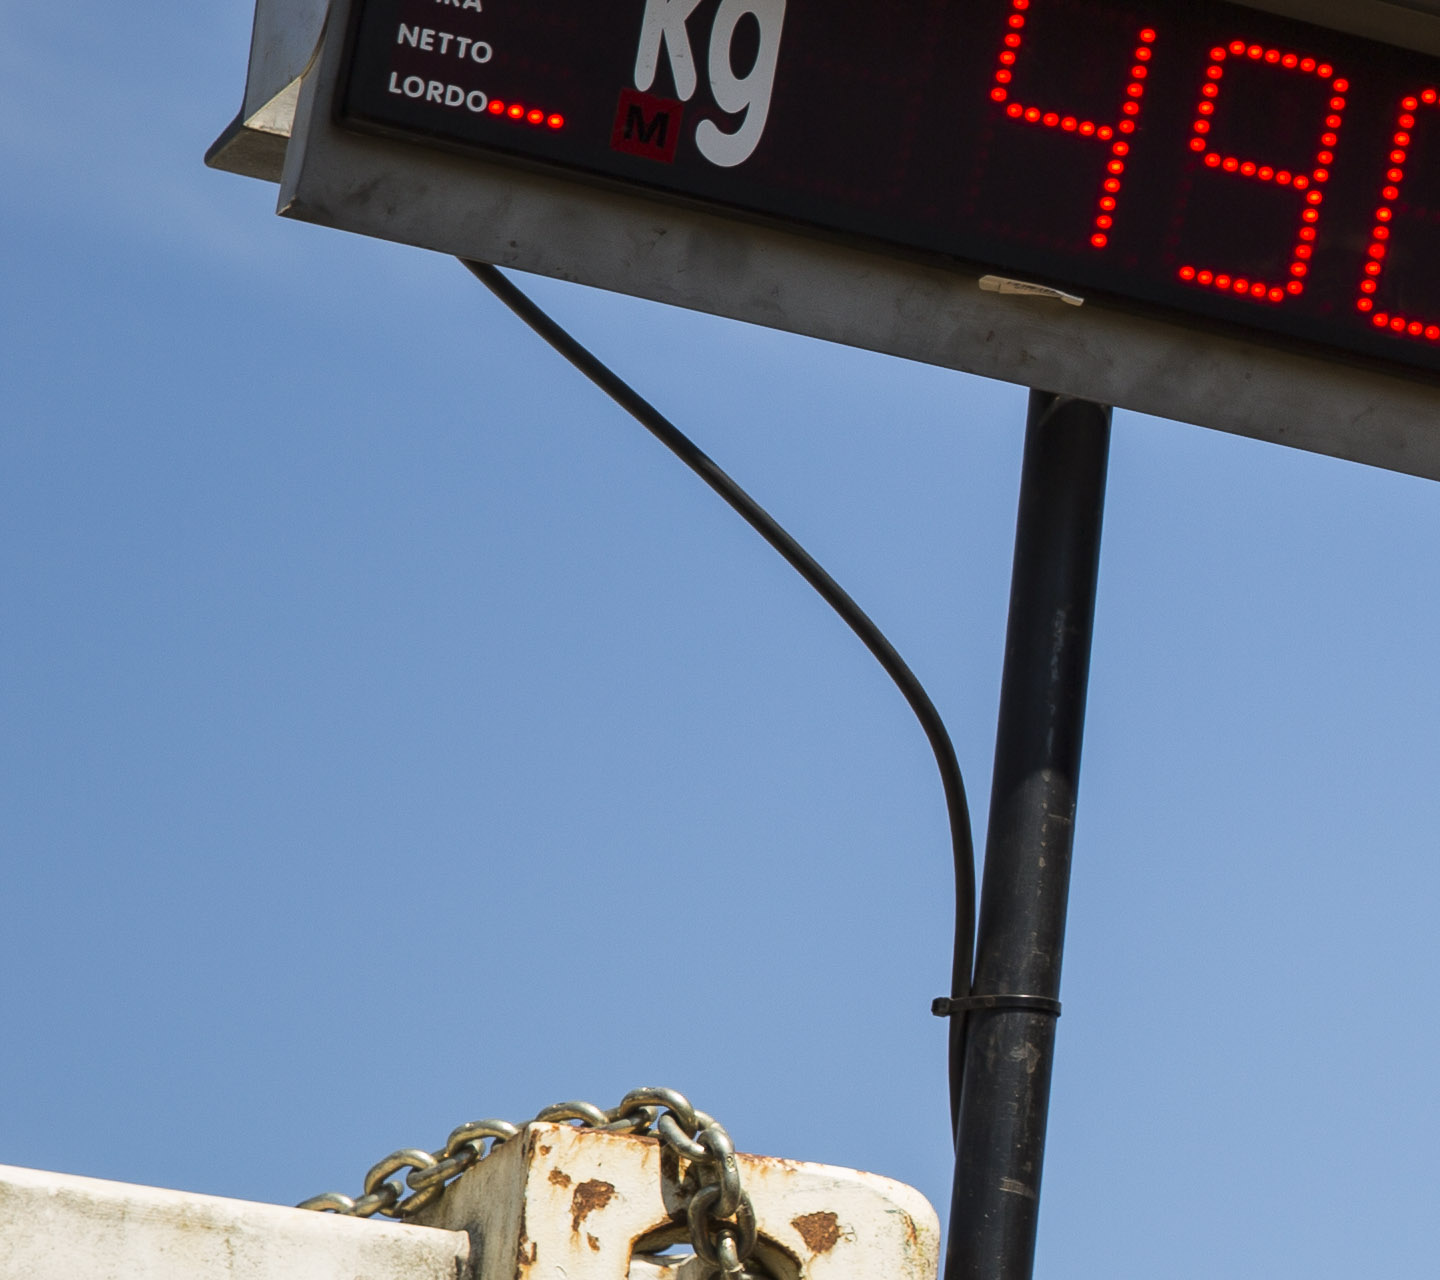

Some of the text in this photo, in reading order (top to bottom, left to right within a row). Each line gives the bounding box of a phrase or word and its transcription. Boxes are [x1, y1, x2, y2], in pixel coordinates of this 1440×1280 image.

[397, 22, 493, 64] NETTO
[388, 71, 488, 113] LORDO
[622, 104, 668, 149] M
